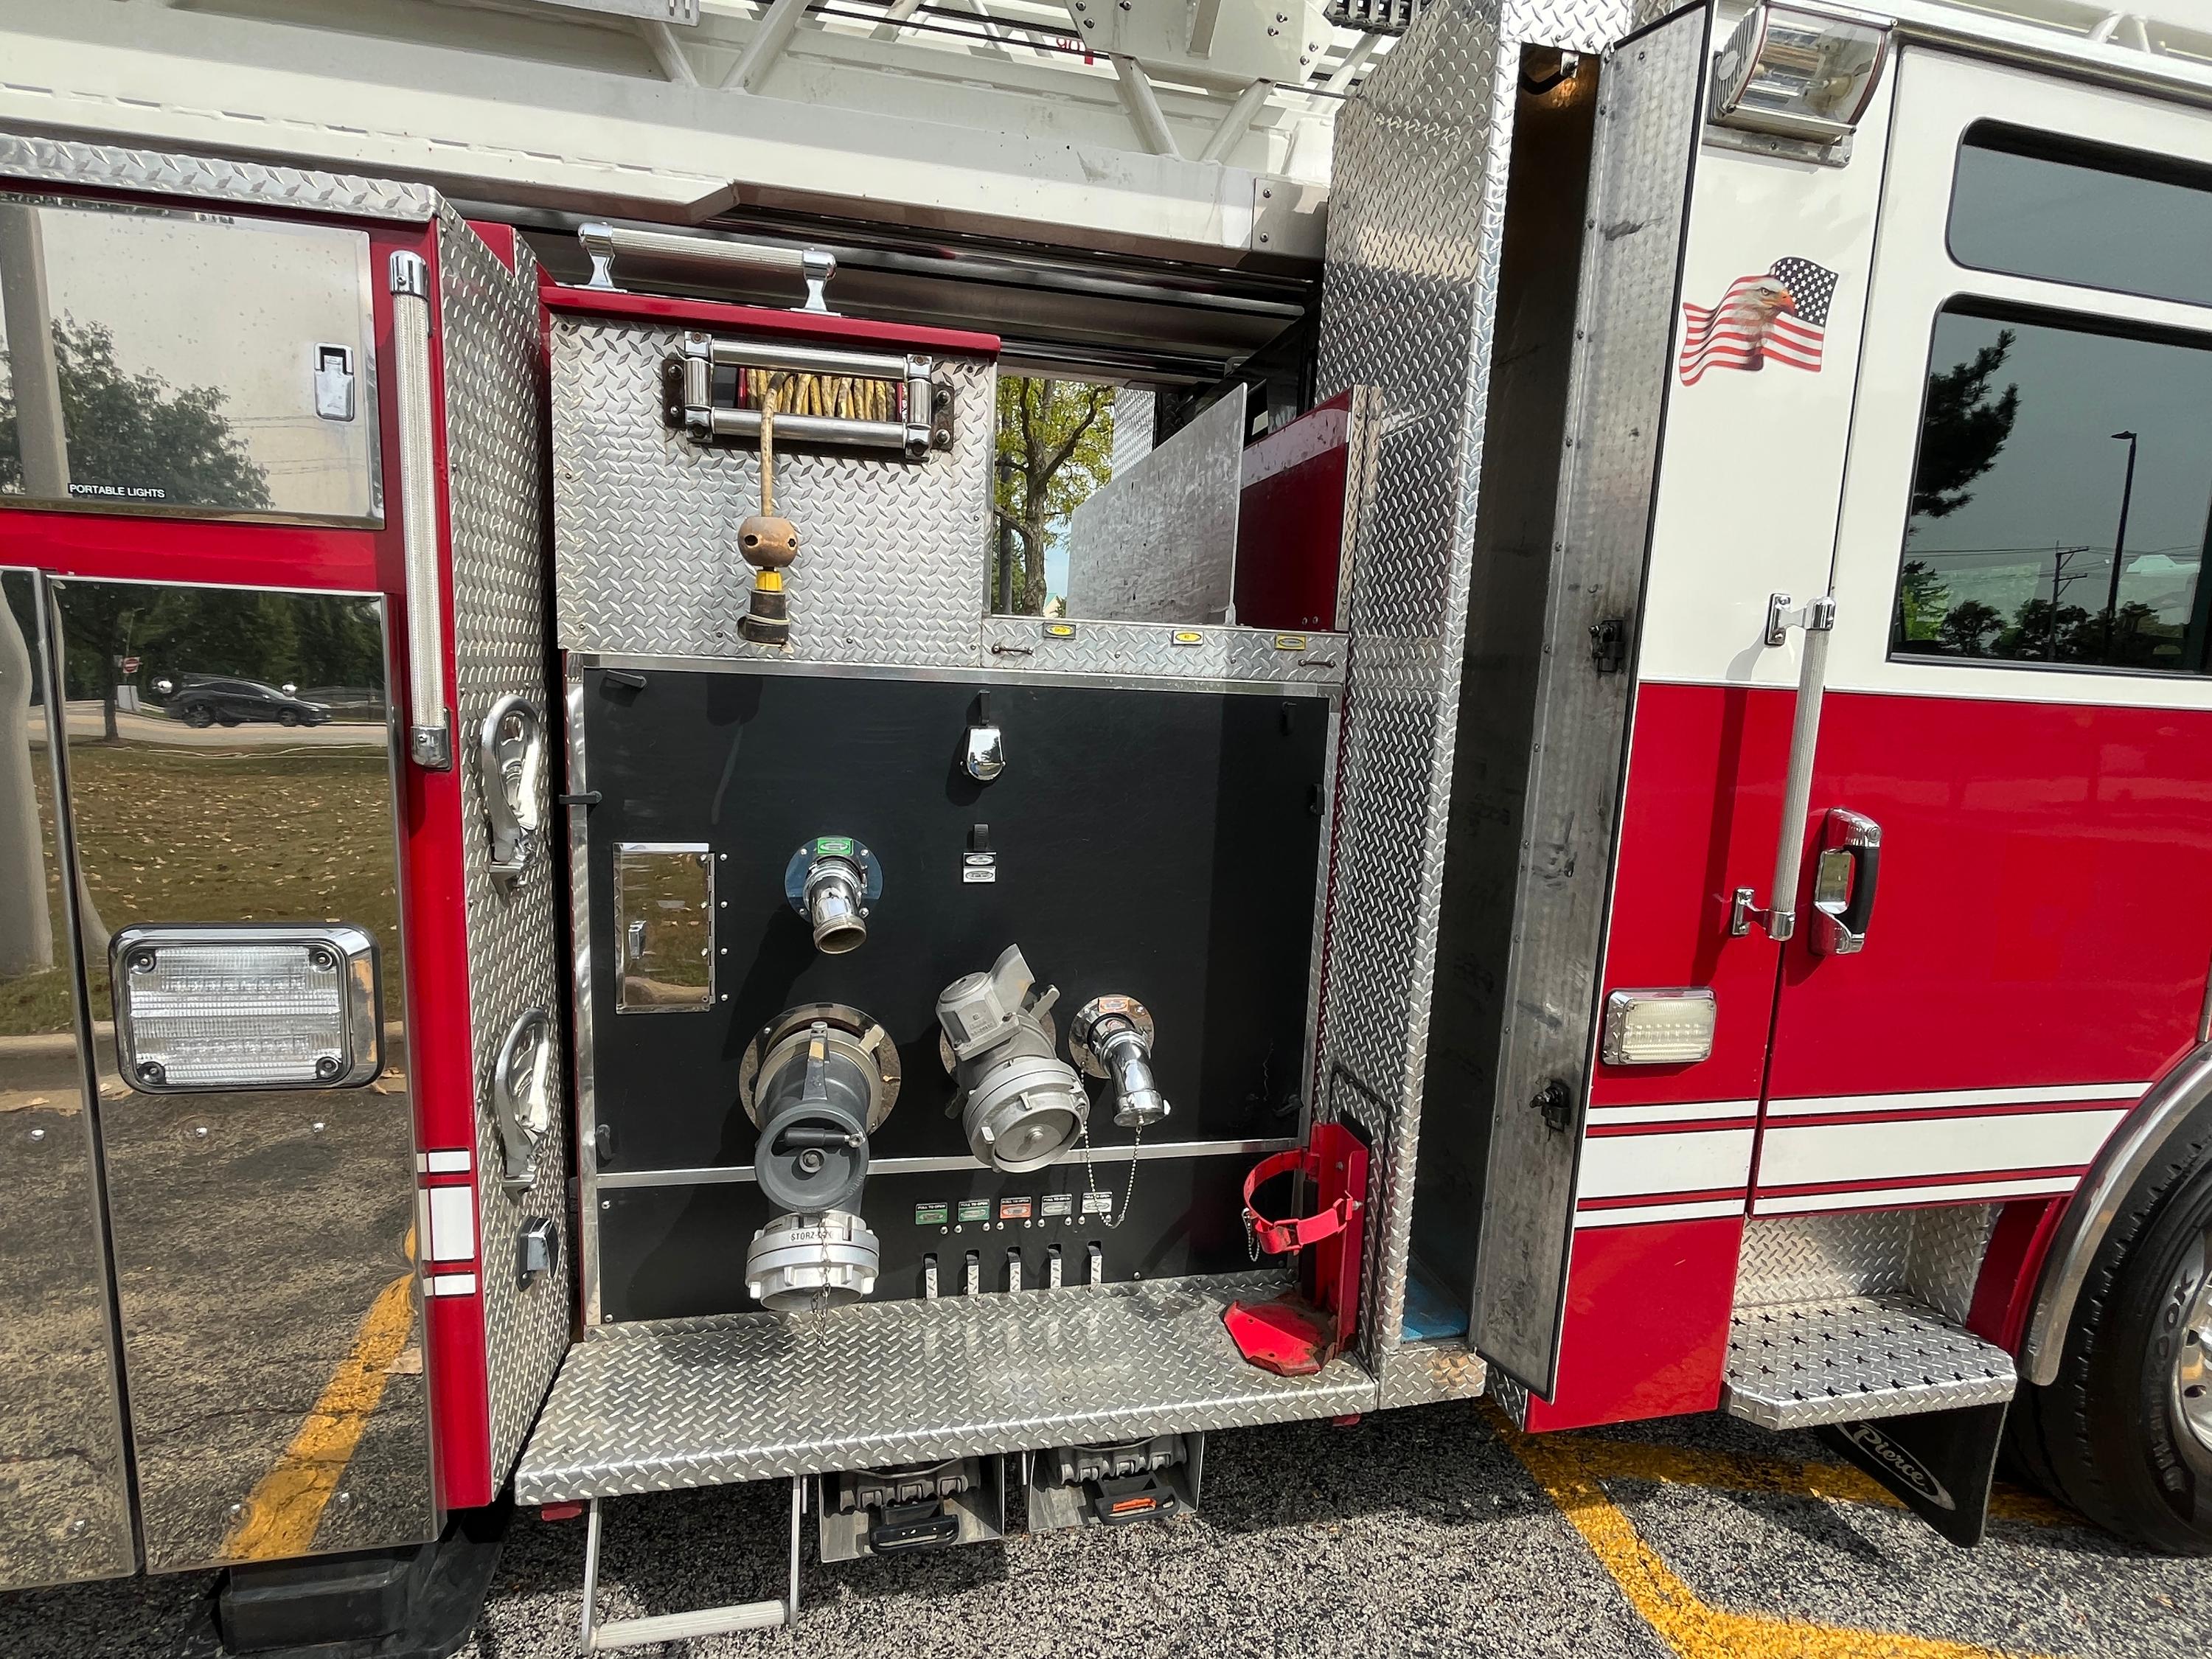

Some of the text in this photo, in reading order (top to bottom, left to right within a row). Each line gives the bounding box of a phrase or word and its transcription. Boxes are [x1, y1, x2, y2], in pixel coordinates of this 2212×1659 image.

[69, 484, 165, 498] PORTABLE LIGHTS
[1853, 1424, 1927, 1487] Pierce
